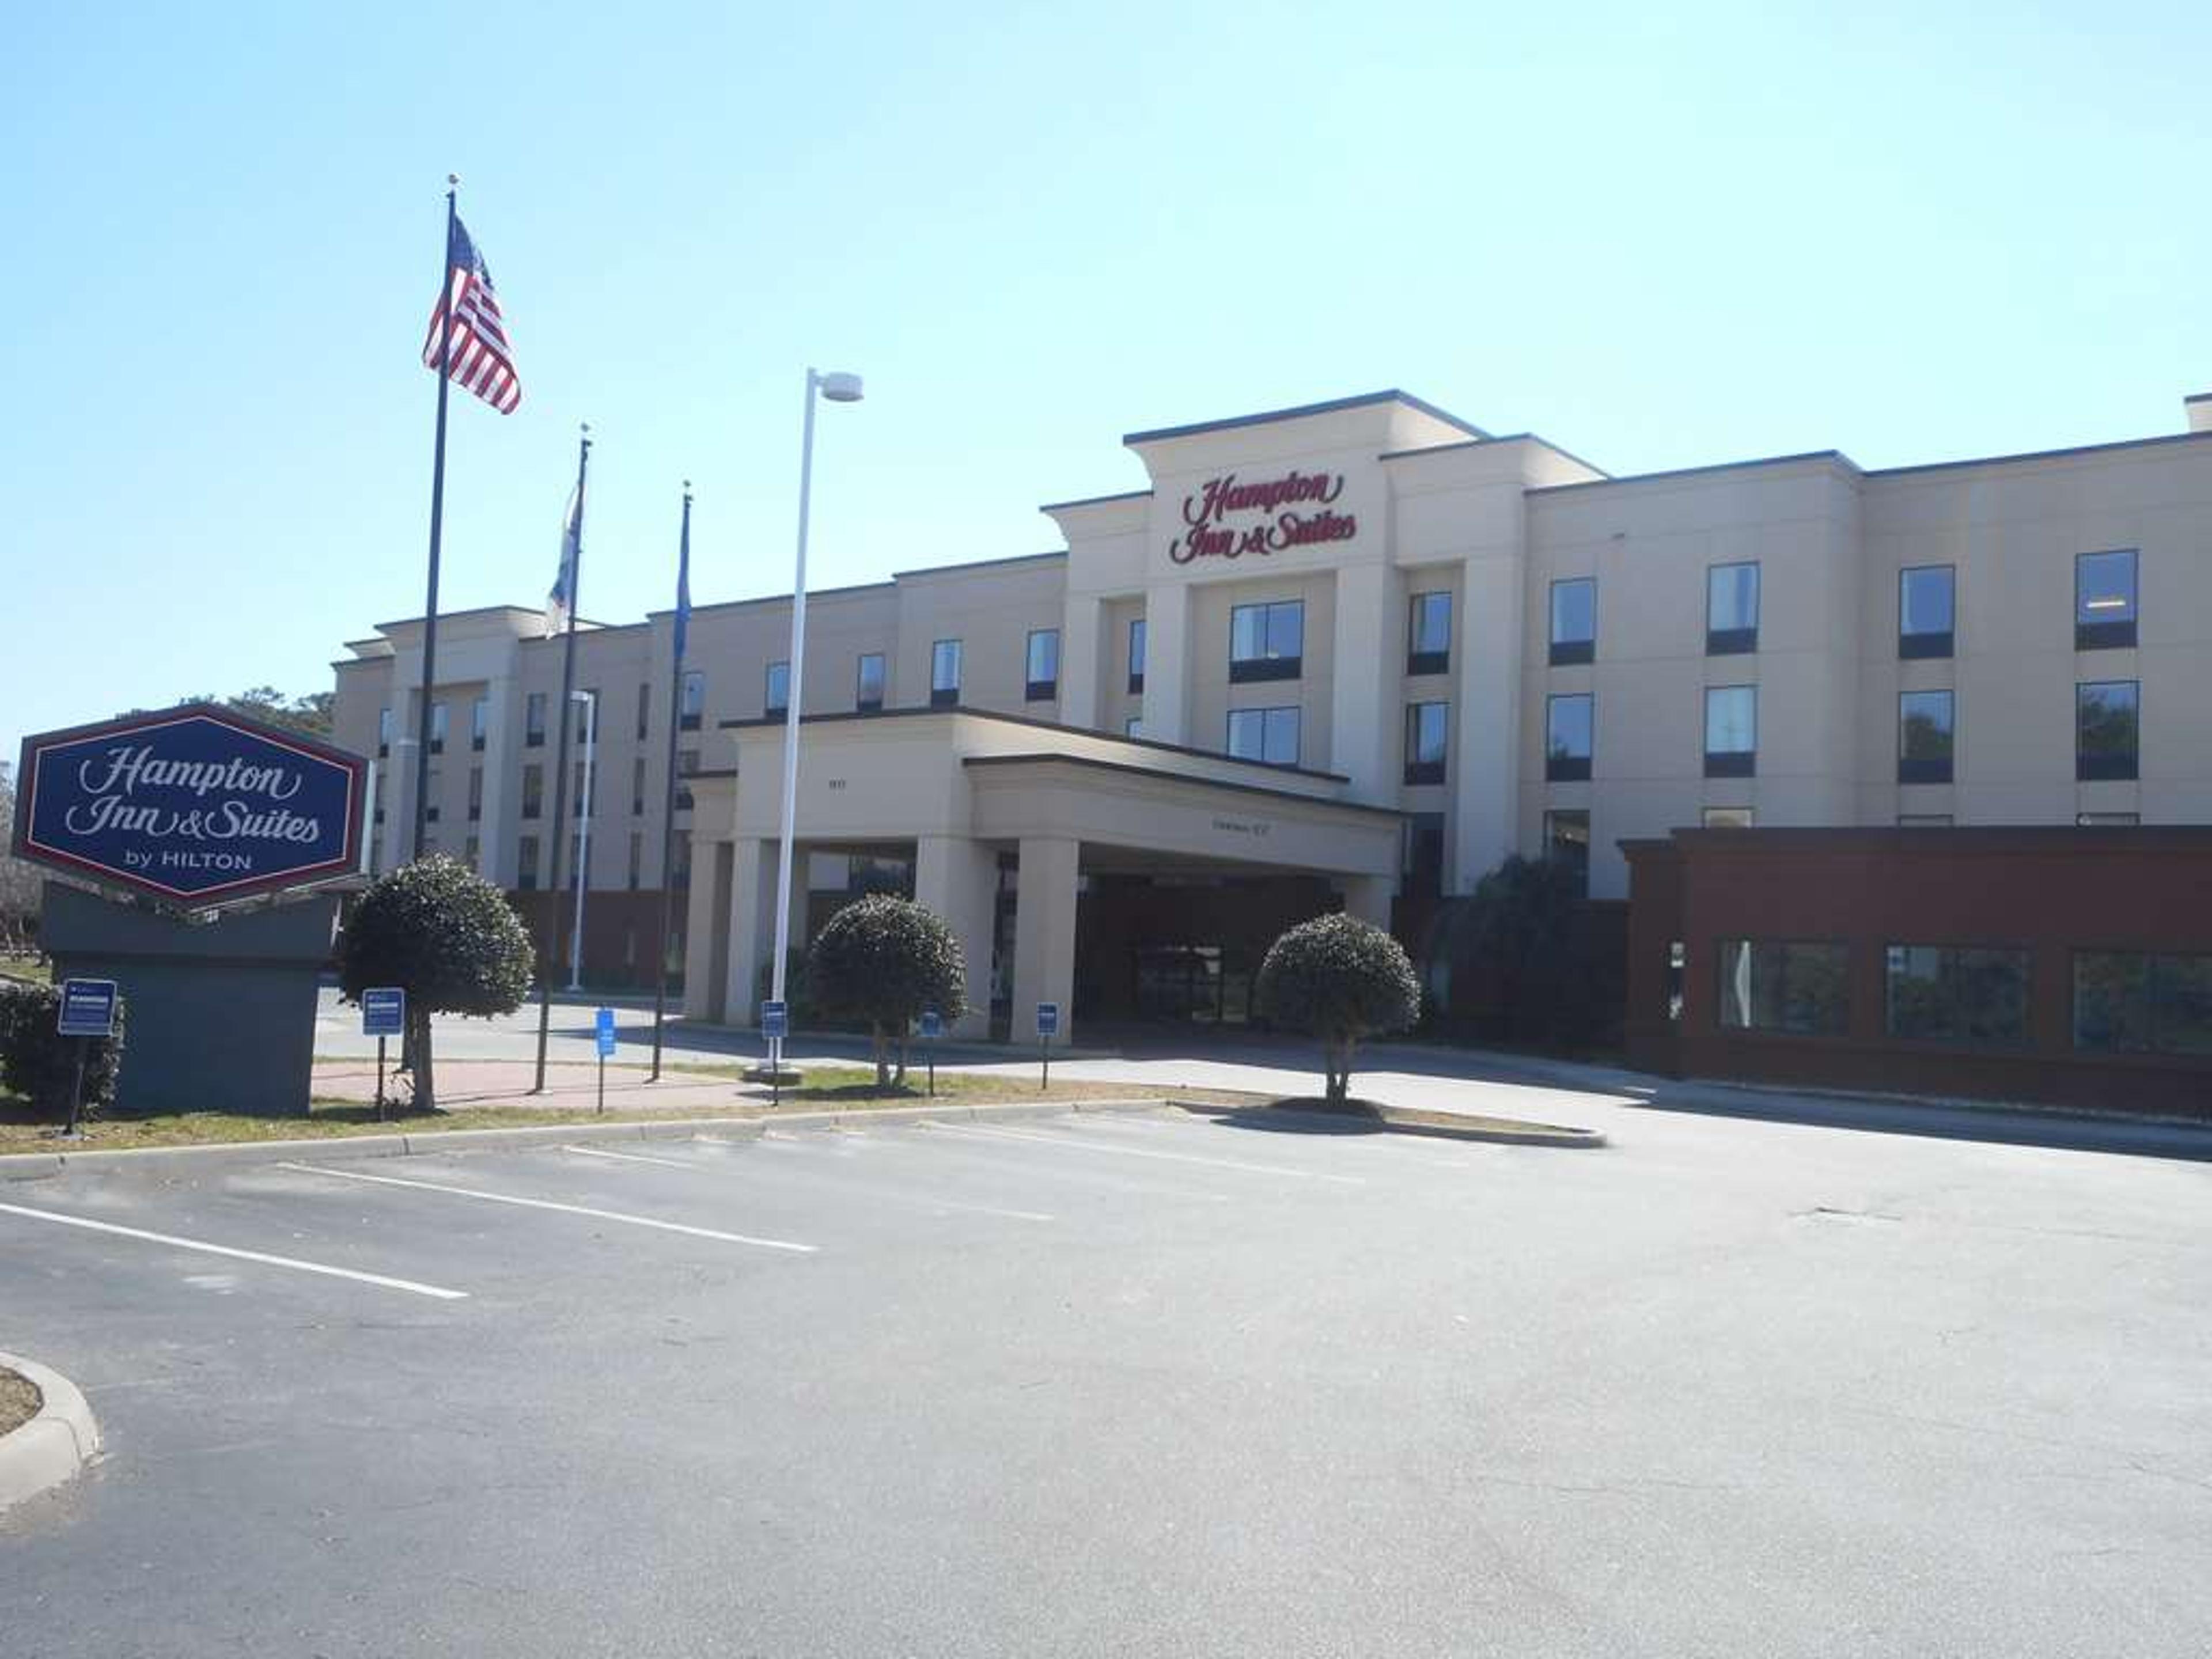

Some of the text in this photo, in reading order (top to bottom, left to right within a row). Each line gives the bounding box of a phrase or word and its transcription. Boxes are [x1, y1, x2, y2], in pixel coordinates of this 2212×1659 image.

[1184, 472, 1343, 525] Hampton
[1170, 510, 1356, 563] Inn & Suites
[79, 745, 302, 800] Hampton
[66, 796, 319, 843] Inn & Suites
[126, 850, 252, 870] by HILTON
